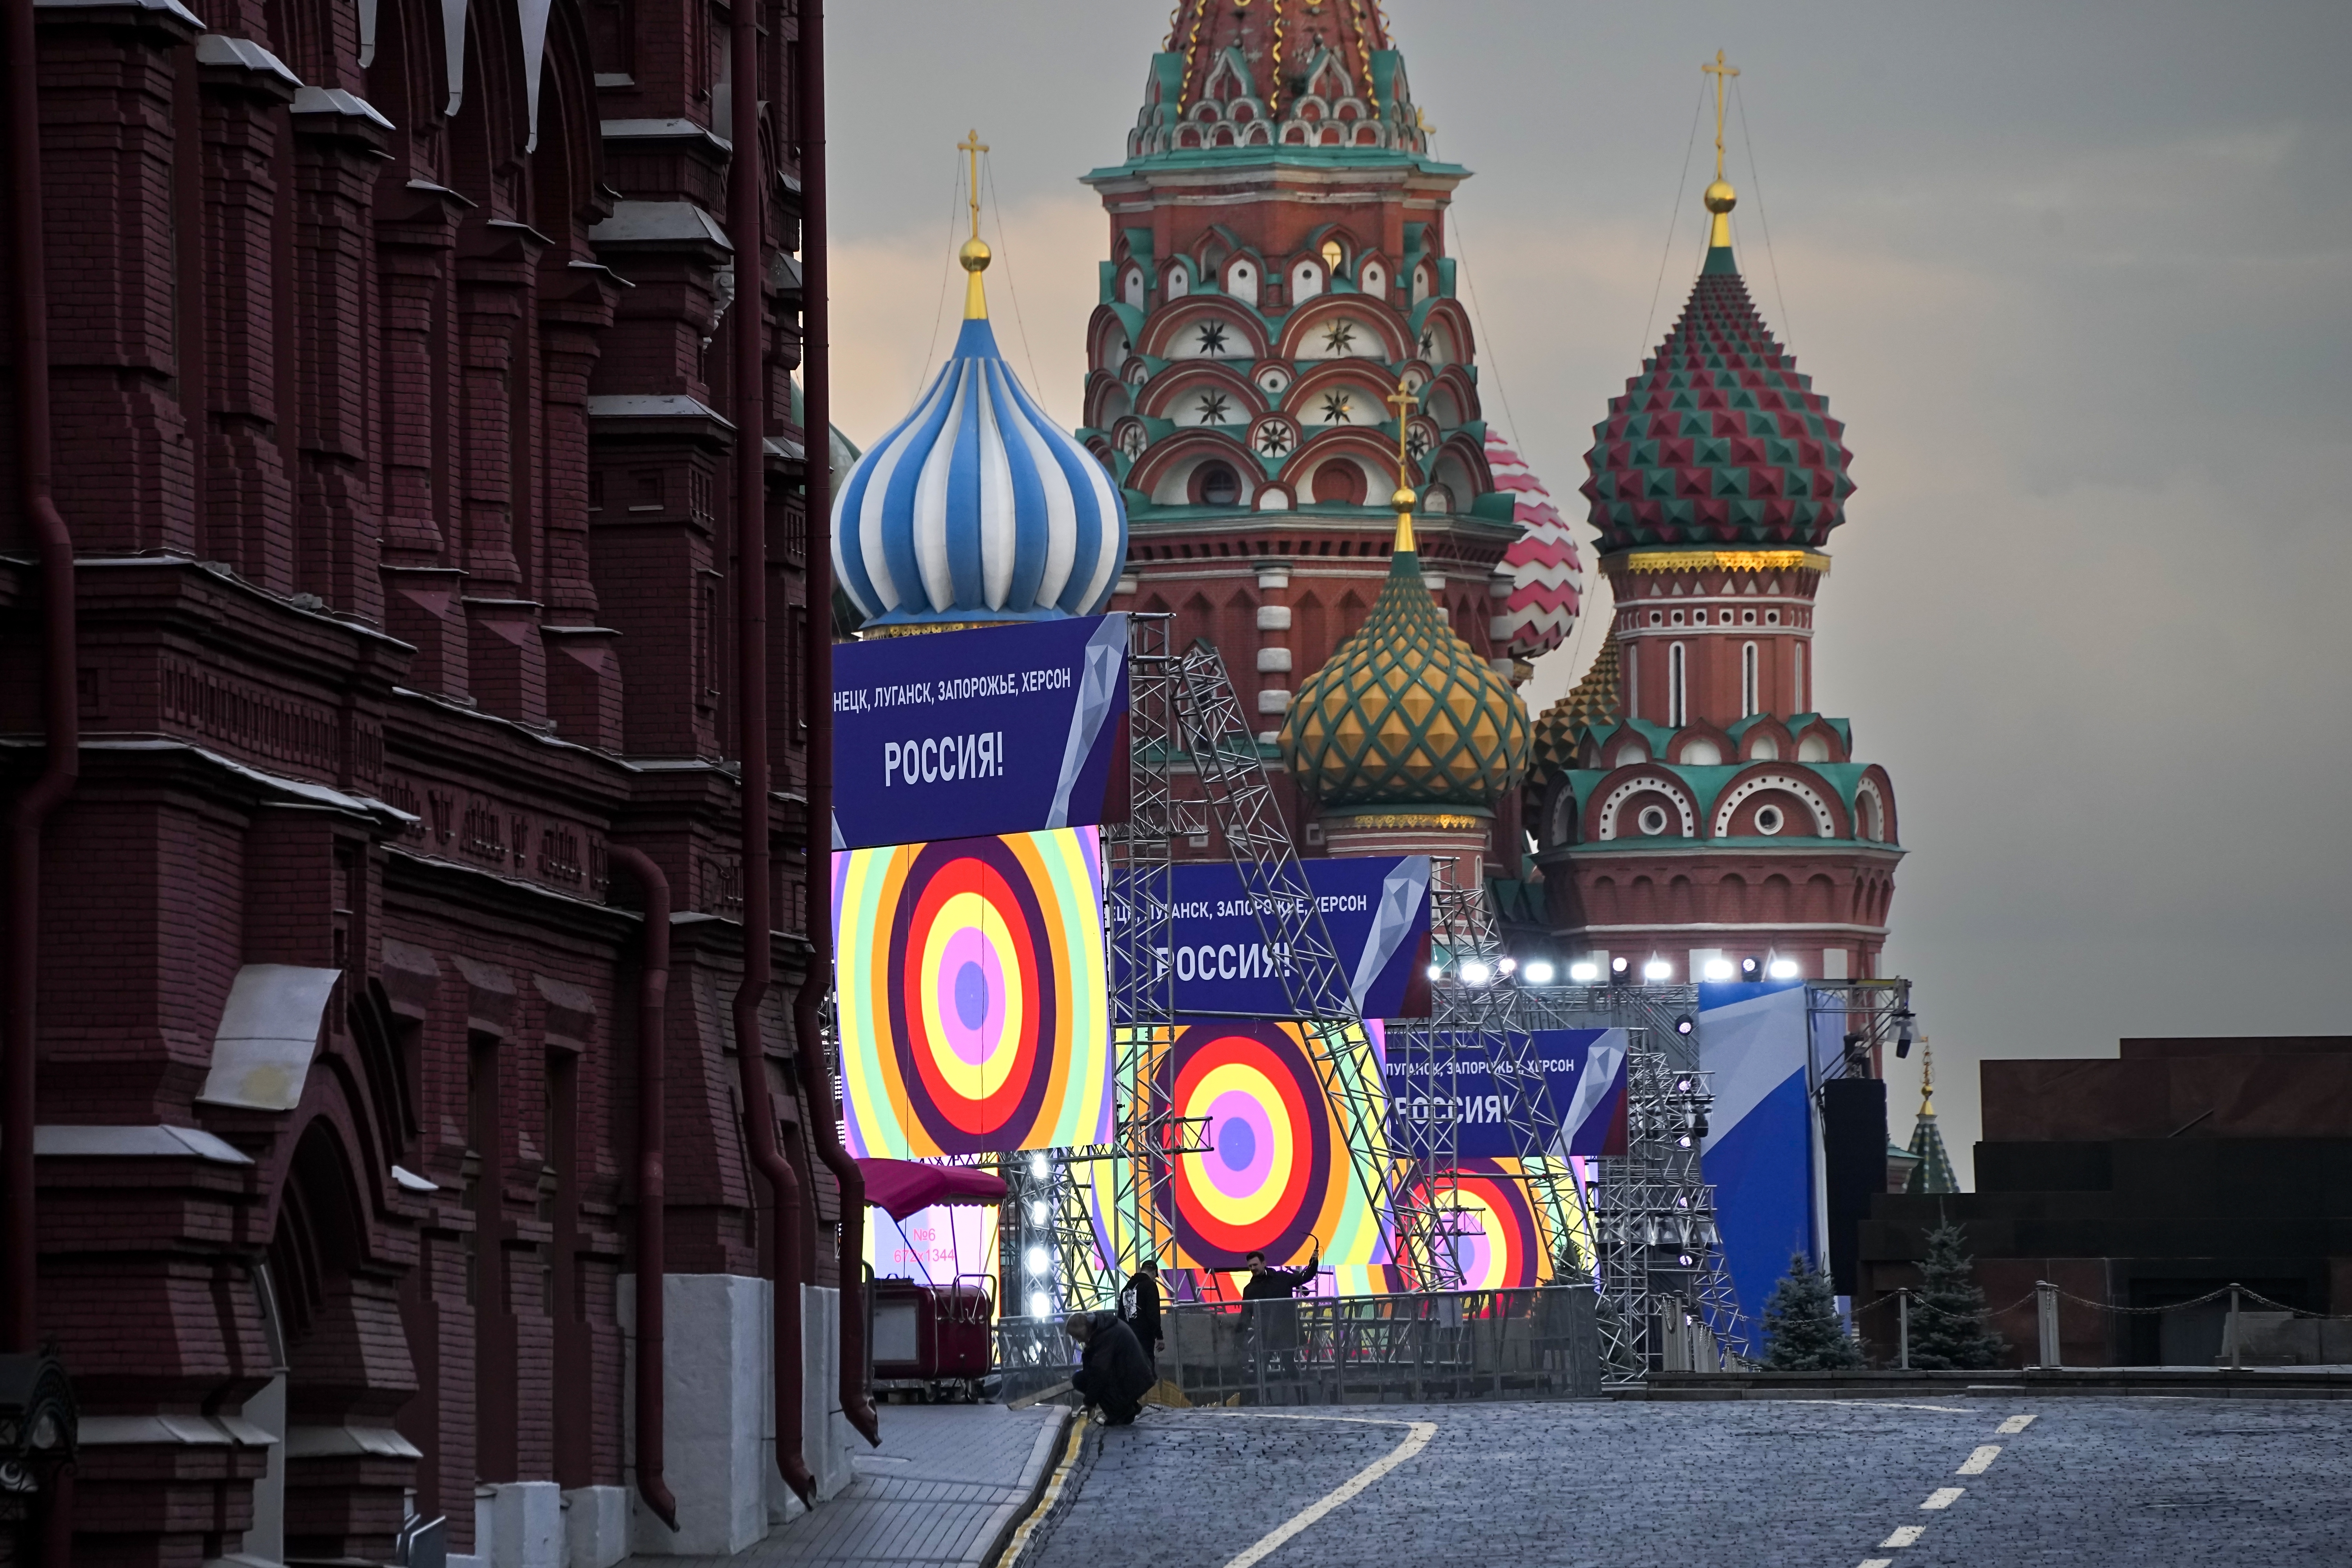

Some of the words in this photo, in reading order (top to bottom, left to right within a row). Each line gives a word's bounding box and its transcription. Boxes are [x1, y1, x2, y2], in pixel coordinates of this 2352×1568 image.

[832, 689, 871, 714] НЕЦК,
[874, 682, 934, 708] ЛУГАНСК,
[938, 673, 1018, 701] ЗАПОРОЖЬЕ,
[1022, 668, 1071, 692] ХЕРСОН
[885, 731, 1003, 787] РОССИЯ!
[1217, 898, 1307, 917] ЗАПОРОЖЕ,
[1156, 942, 1290, 982] РОССИЯ!
[913, 1228, 936, 1241] №6
